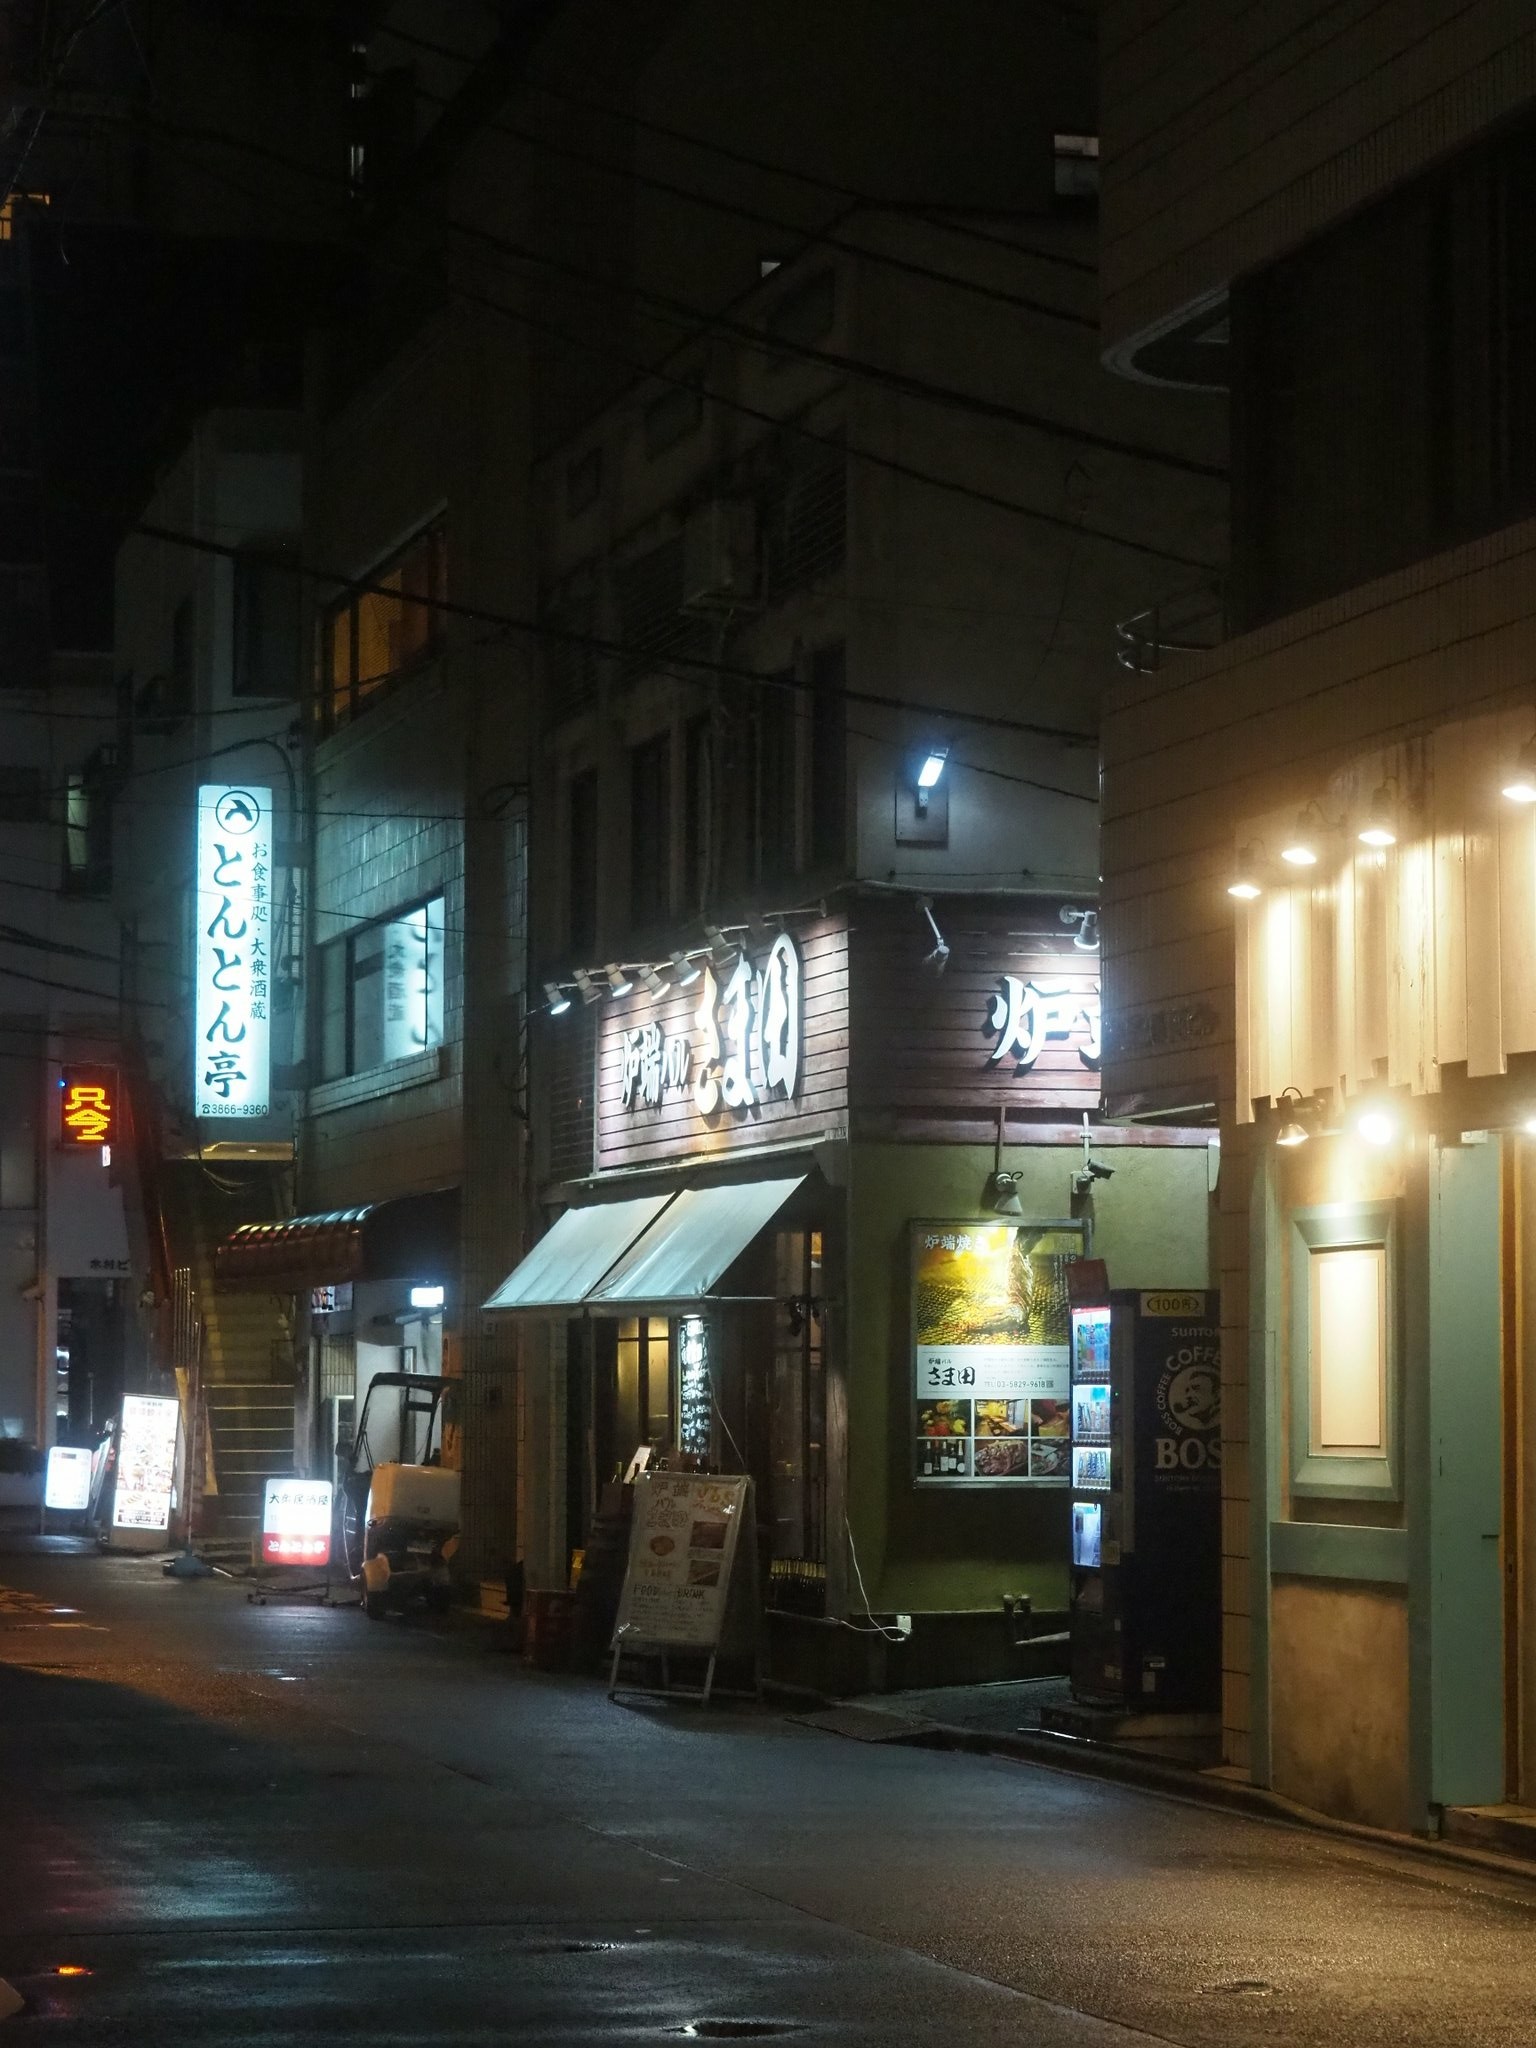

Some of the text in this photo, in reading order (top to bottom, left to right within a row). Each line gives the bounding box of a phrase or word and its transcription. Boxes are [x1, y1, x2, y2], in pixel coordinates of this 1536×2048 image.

[204, 843, 248, 1099] とんとん亭
[693, 932, 800, 1115] さま田
[211, 1103, 269, 1117] 3866-9360
[927, 1366, 976, 1386] さま田
